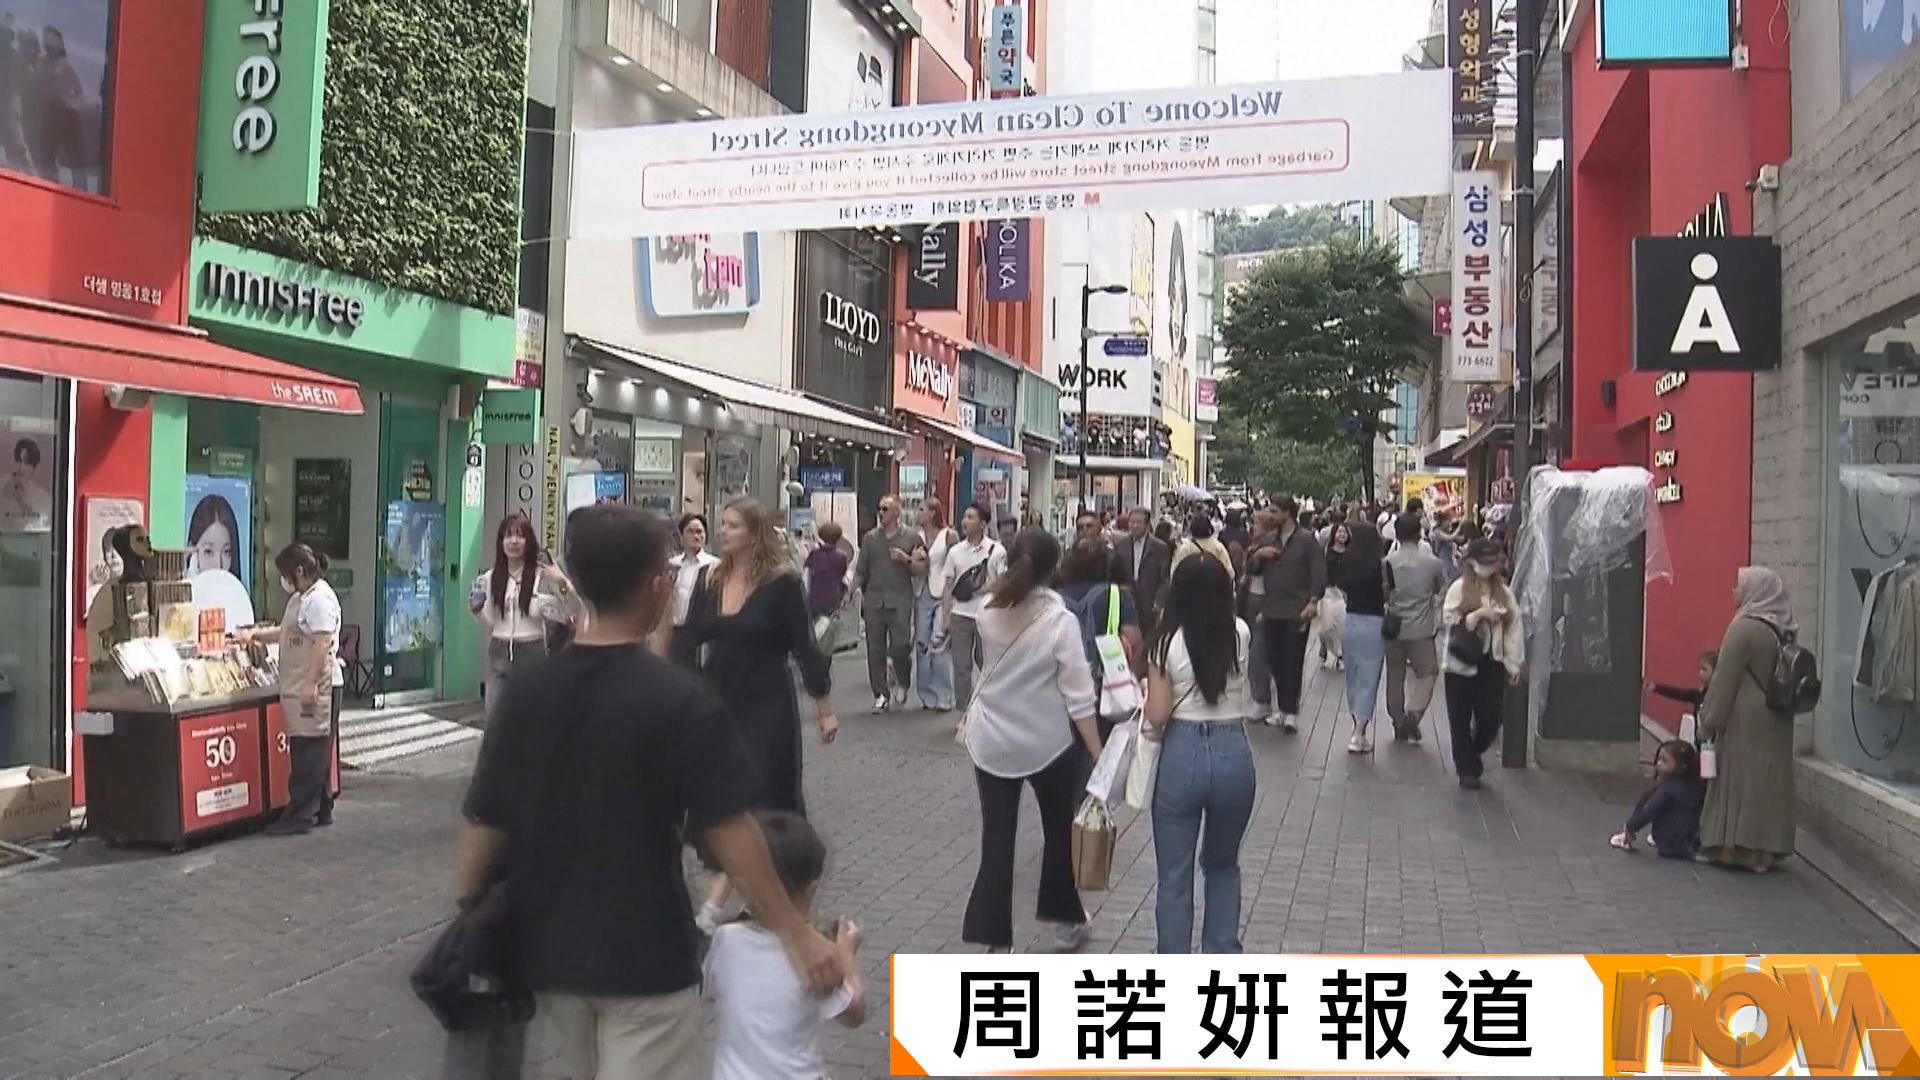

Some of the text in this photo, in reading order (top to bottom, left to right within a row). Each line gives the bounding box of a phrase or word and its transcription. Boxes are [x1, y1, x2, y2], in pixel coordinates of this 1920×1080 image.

[998, 12, 1016, 86] 푸른약국
[1461, 185, 1493, 349] 삼성부동산
[825, 292, 880, 344] LLOYD
[909, 350, 953, 407] McNally
[1058, 363, 1127, 390] WORK
[205, 736, 236, 768] 50
